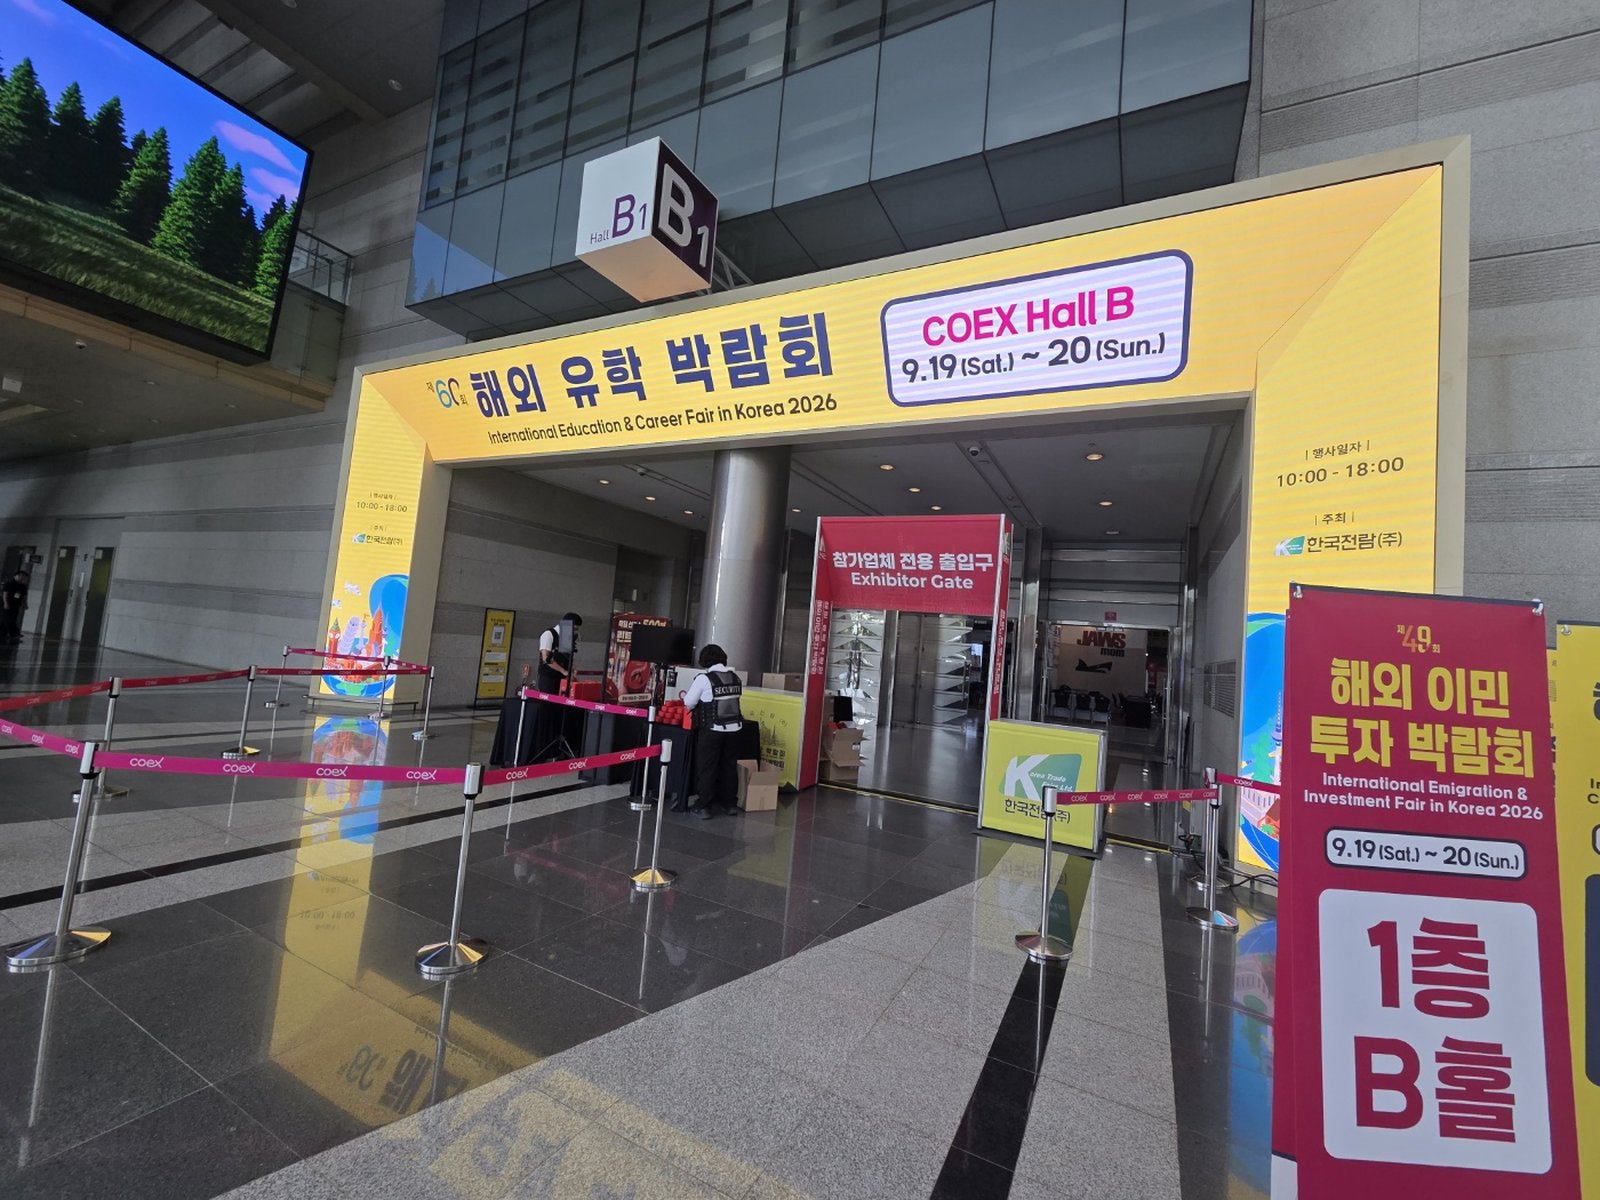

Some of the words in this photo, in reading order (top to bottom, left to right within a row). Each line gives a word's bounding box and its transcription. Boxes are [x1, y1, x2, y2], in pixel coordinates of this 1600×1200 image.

[590, 230, 610, 244] Hall
[922, 303, 1019, 347] COEX
[1026, 290, 1096, 332] Hall
[1106, 285, 1134, 321] B
[469, 363, 547, 418] 해외
[560, 346, 647, 408] 유학
[666, 312, 834, 393] 박람회
[488, 425, 558, 444] International
[558, 419, 622, 438] Education
[624, 417, 634, 431] &
[635, 413, 682, 430] Career
[685, 409, 714, 425] Fair
[718, 406, 733, 422] in
[734, 403, 785, 420] Korea
[787, 393, 837, 415] 2026
[1312, 441, 1362, 459] 행사일자
[1277, 468, 1327, 487] 10:00
[1345, 456, 1404, 478] 18:00
[357, 501, 378, 510] 10:00
[385, 504, 407, 512] 18:00
[1322, 512, 1346, 525] 주최
[1306, 531, 1403, 553] 한국전람(주)
[832, 552, 896, 570] 참가업체
[900, 552, 934, 571] 전용
[939, 553, 994, 572] 출입구
[851, 572, 927, 588] Exhibitor
[931, 575, 974, 589] Gate
[1077, 630, 1126, 649] JAWS
[1331, 657, 1412, 710] 해외
[1427, 666, 1510, 718] 이민
[31, 734, 45, 744] coex
[65, 743, 80, 754] coex
[1310, 715, 1394, 768] 투자
[1408, 722, 1534, 778] 박람회
[130, 757, 165, 768] coex
[222, 762, 256, 773] coex
[316, 766, 348, 777] coex
[406, 769, 437, 780] coex
[506, 767, 529, 780] coex
[568, 759, 588, 770] coex
[620, 749, 637, 761] coex
[1233, 778, 1254, 787] coex
[1322, 772, 1425, 794] International
[1429, 780, 1513, 799] Emigration
[1517, 787, 1528, 801] &
[1100, 793, 1116, 801] coex
[1127, 791, 1143, 800] coex
[1154, 792, 1168, 800] coex
[1179, 791, 1193, 799] coex
[1304, 790, 1391, 809] Investment
[1394, 796, 1426, 812] Fair
[1430, 799, 1444, 813] in
[1449, 801, 1496, 817] Korea
[1500, 804, 1544, 820] 2026
[1005, 799, 1070, 824] 한국전(주)
[1366, 917, 1490, 1019] 1층
[1353, 1035, 1516, 1143] B홀
